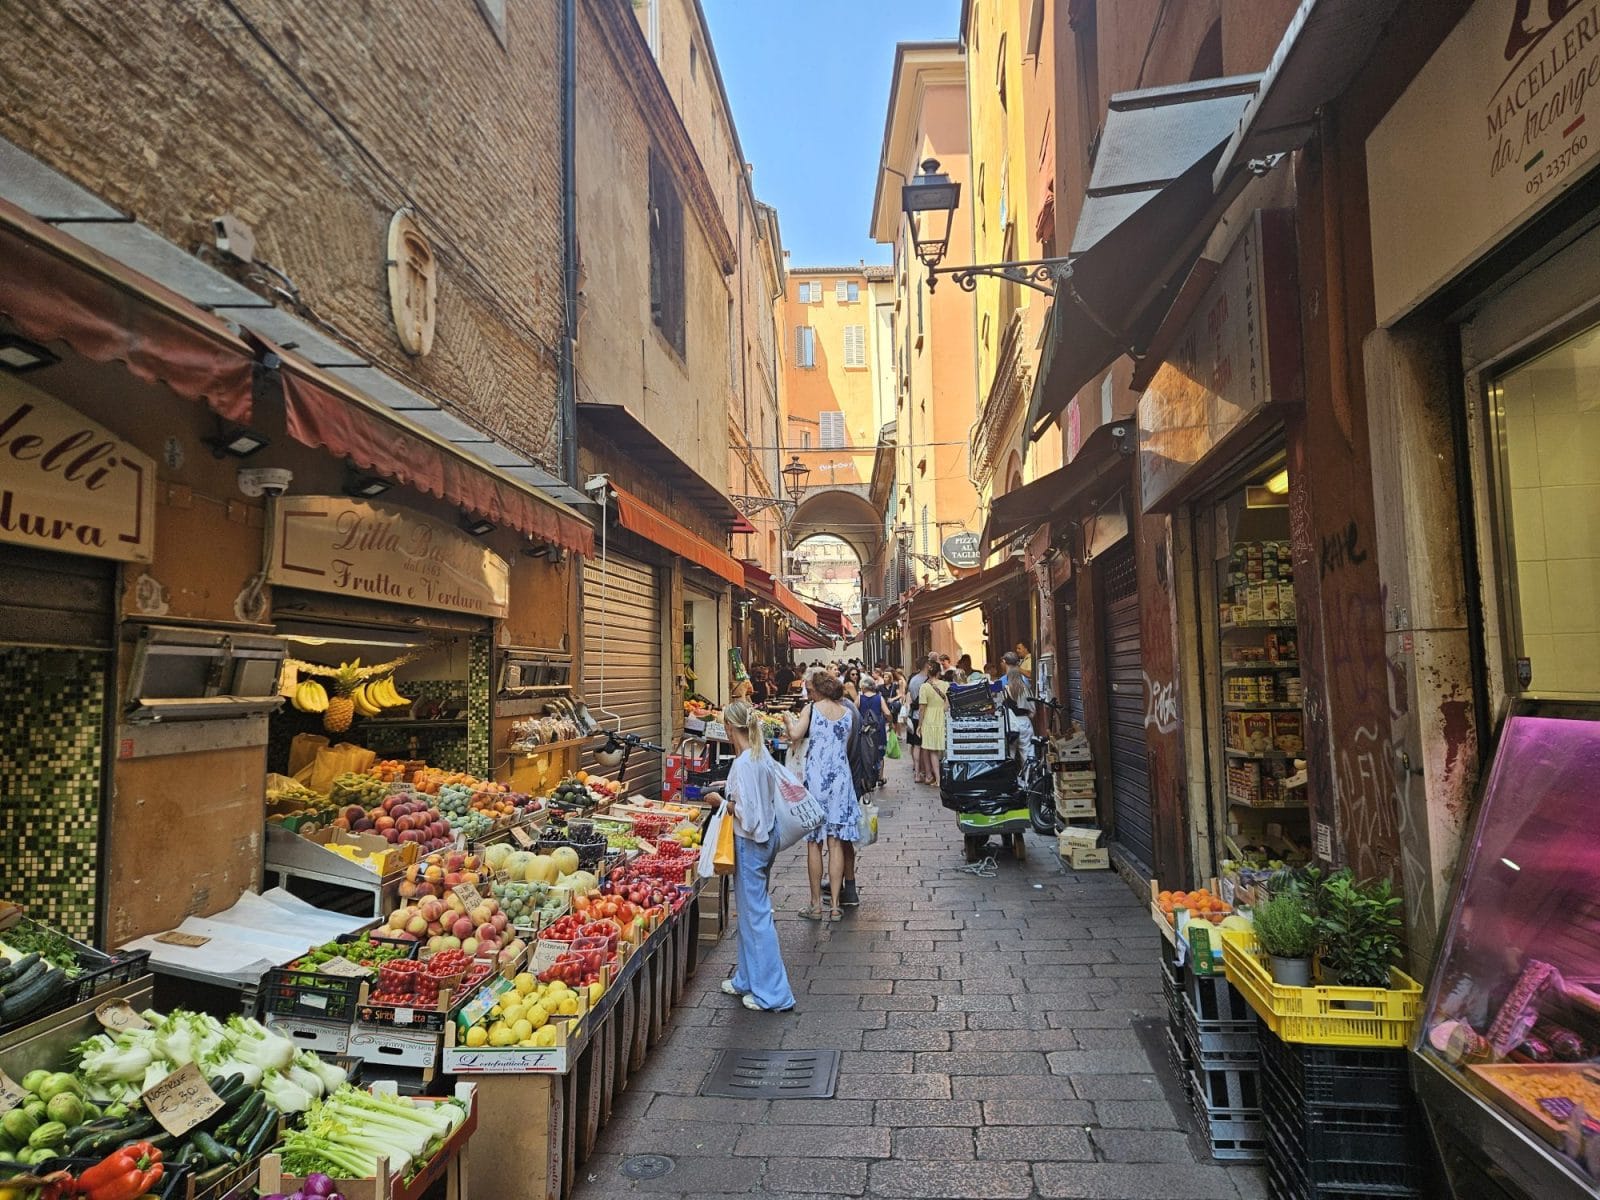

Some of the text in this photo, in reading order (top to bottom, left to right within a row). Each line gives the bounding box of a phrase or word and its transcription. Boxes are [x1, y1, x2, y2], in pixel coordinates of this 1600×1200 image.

[1491, 133, 1515, 178] da
[1526, 134, 1588, 195] 051 233760
[332, 510, 400, 552] Ditta
[955, 537, 978, 545] PIZZA
[331, 558, 483, 612] Frutta e Verdura
